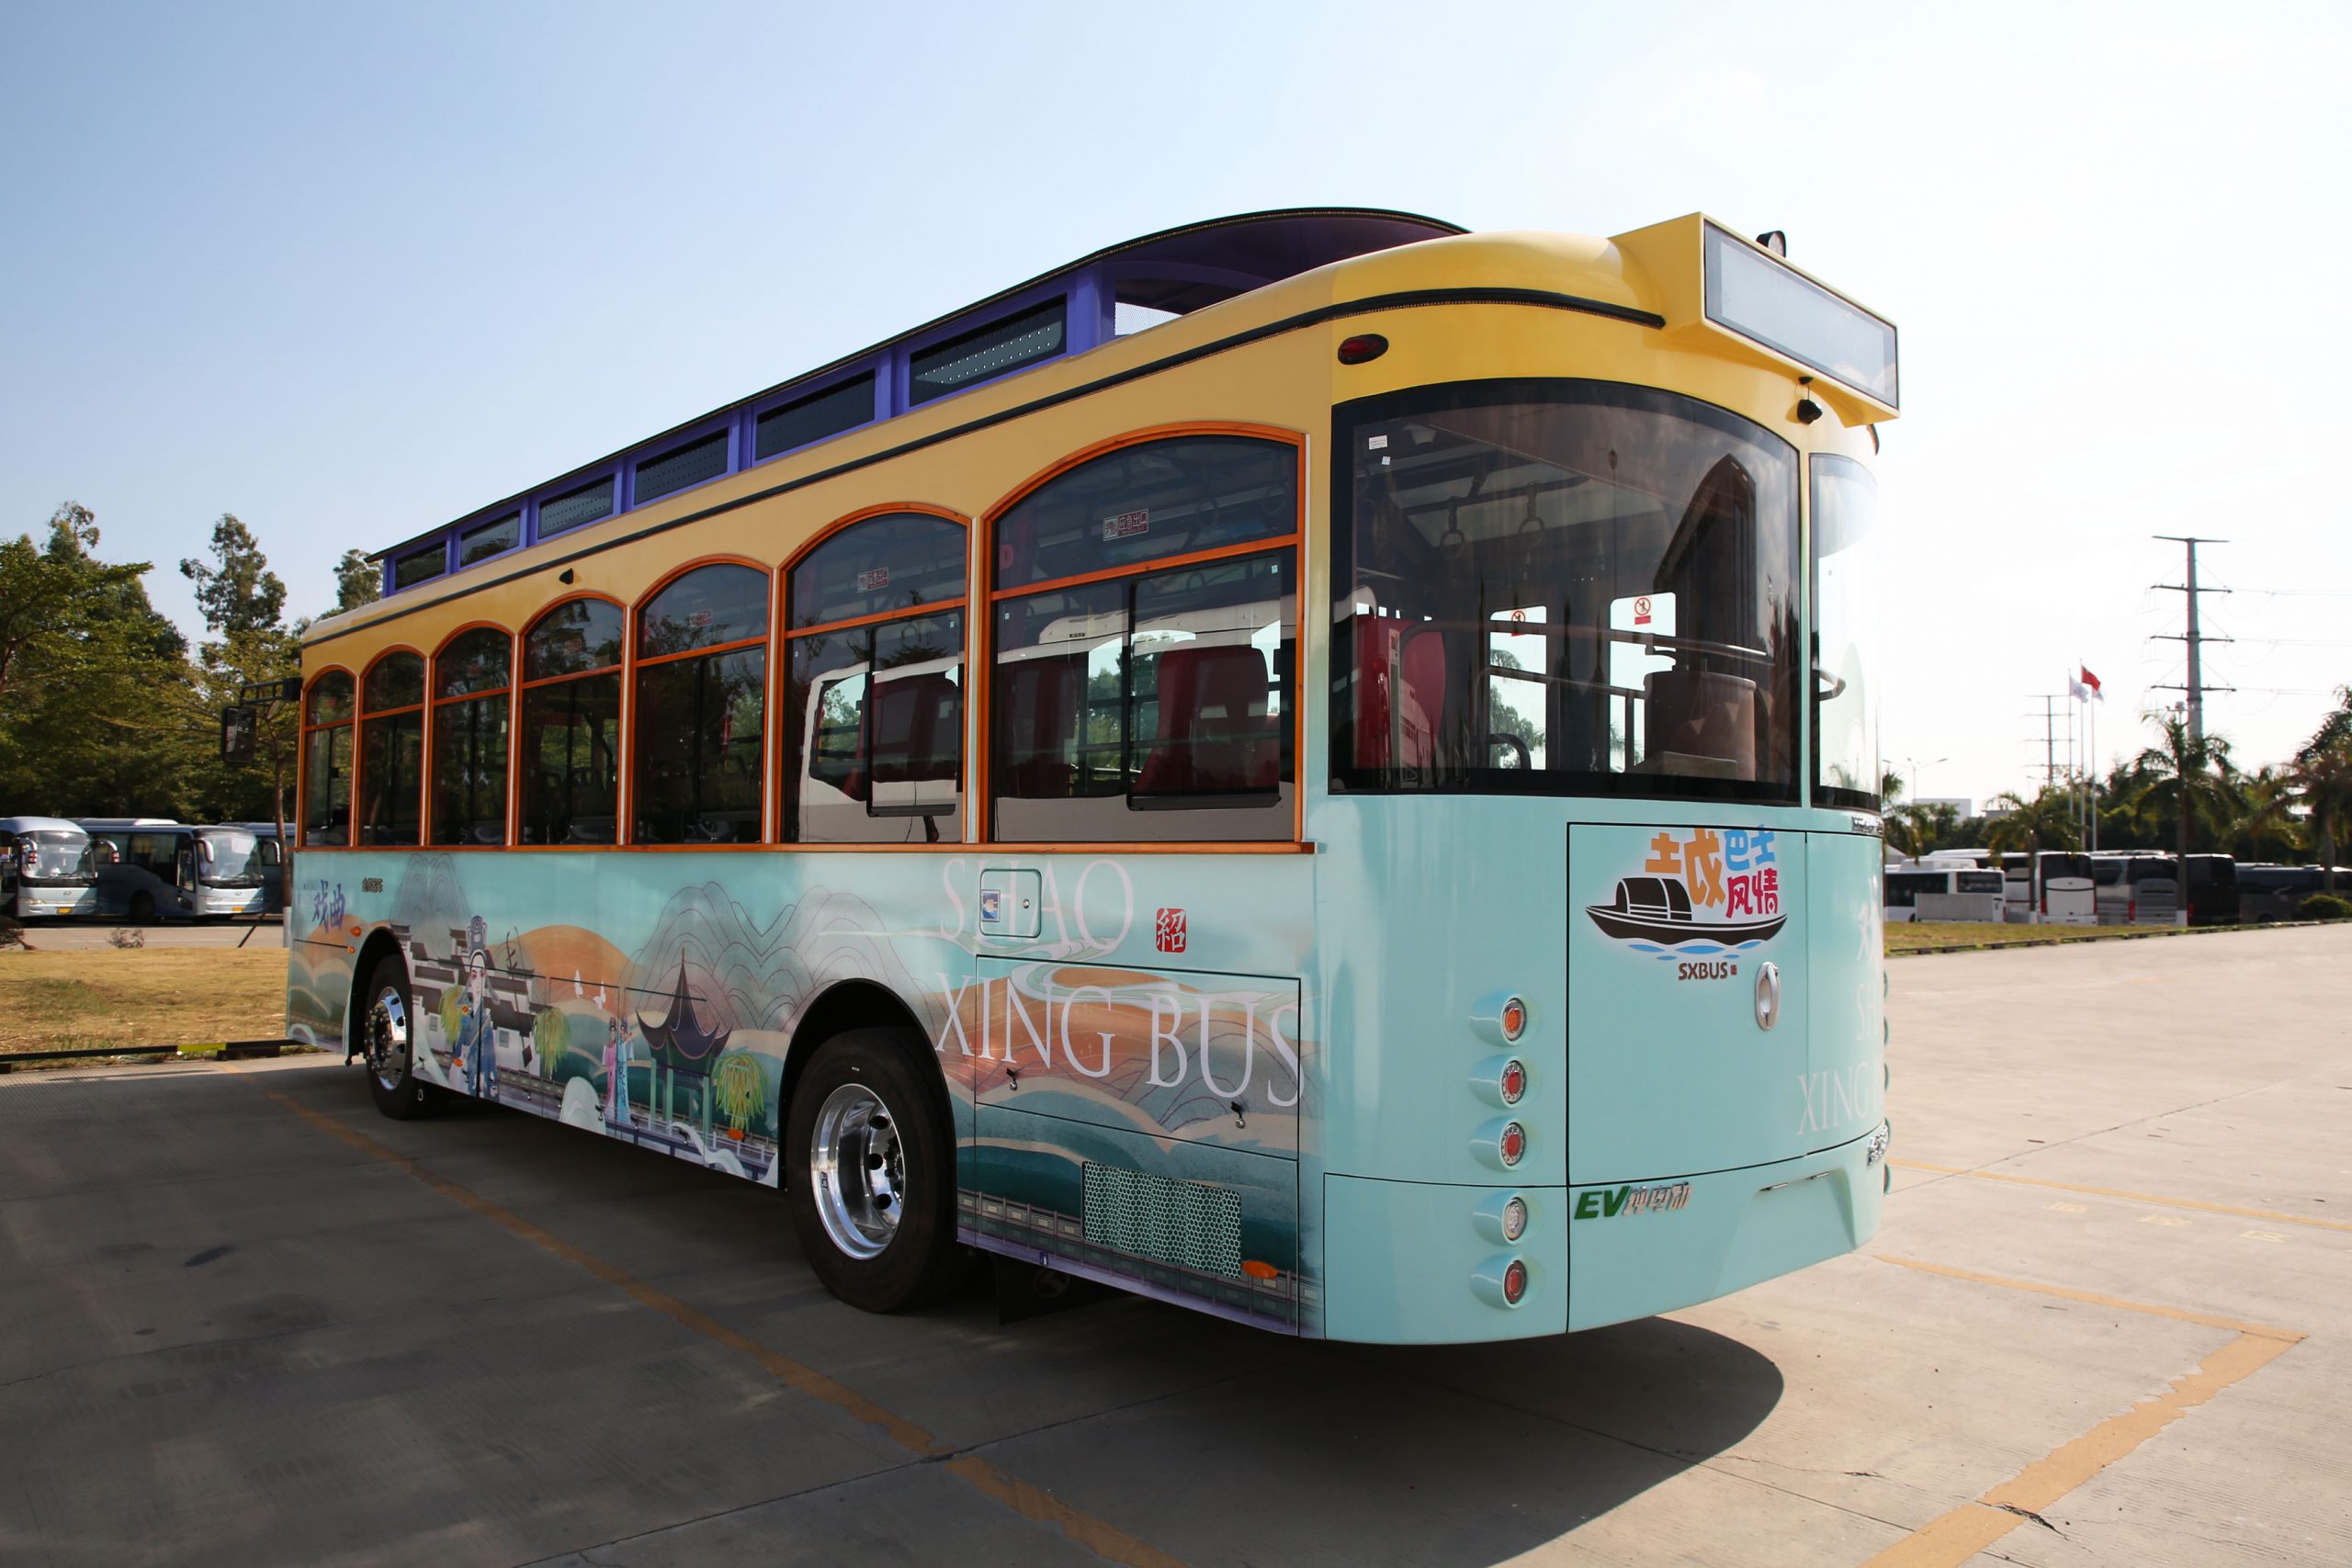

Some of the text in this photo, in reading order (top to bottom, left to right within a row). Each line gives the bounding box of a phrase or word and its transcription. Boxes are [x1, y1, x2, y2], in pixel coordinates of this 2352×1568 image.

[941, 858, 1134, 952] SHAO
[1725, 868, 1778, 919] 风情
[1678, 962, 1728, 980] SXBUS
[934, 972, 1305, 1107] XING BUS
[1856, 981, 1882, 1042] SH
[1796, 1061, 1868, 1136] XING
